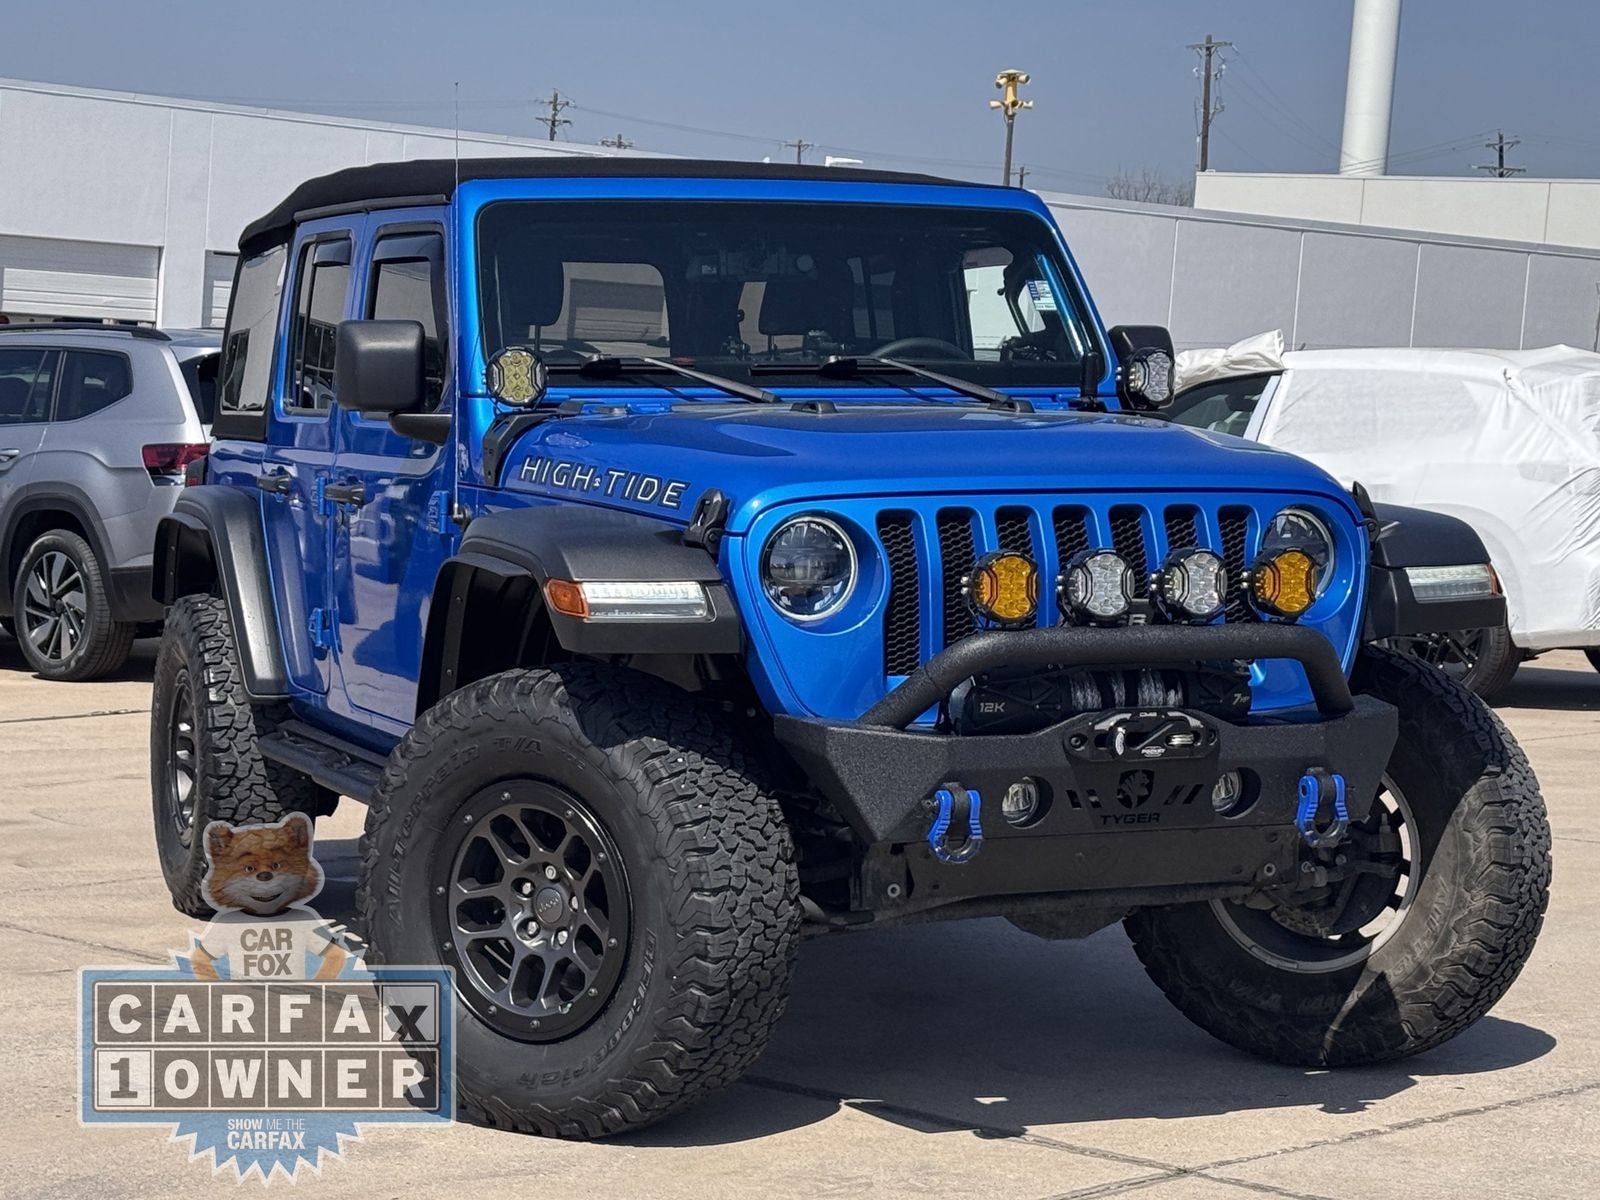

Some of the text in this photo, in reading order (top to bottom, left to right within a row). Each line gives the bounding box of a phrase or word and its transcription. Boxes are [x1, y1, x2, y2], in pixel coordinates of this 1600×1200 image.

[519, 456, 688, 508] HIGH TIDE
[979, 702, 1006, 713] 12K
[1100, 813, 1160, 825] TYGER
